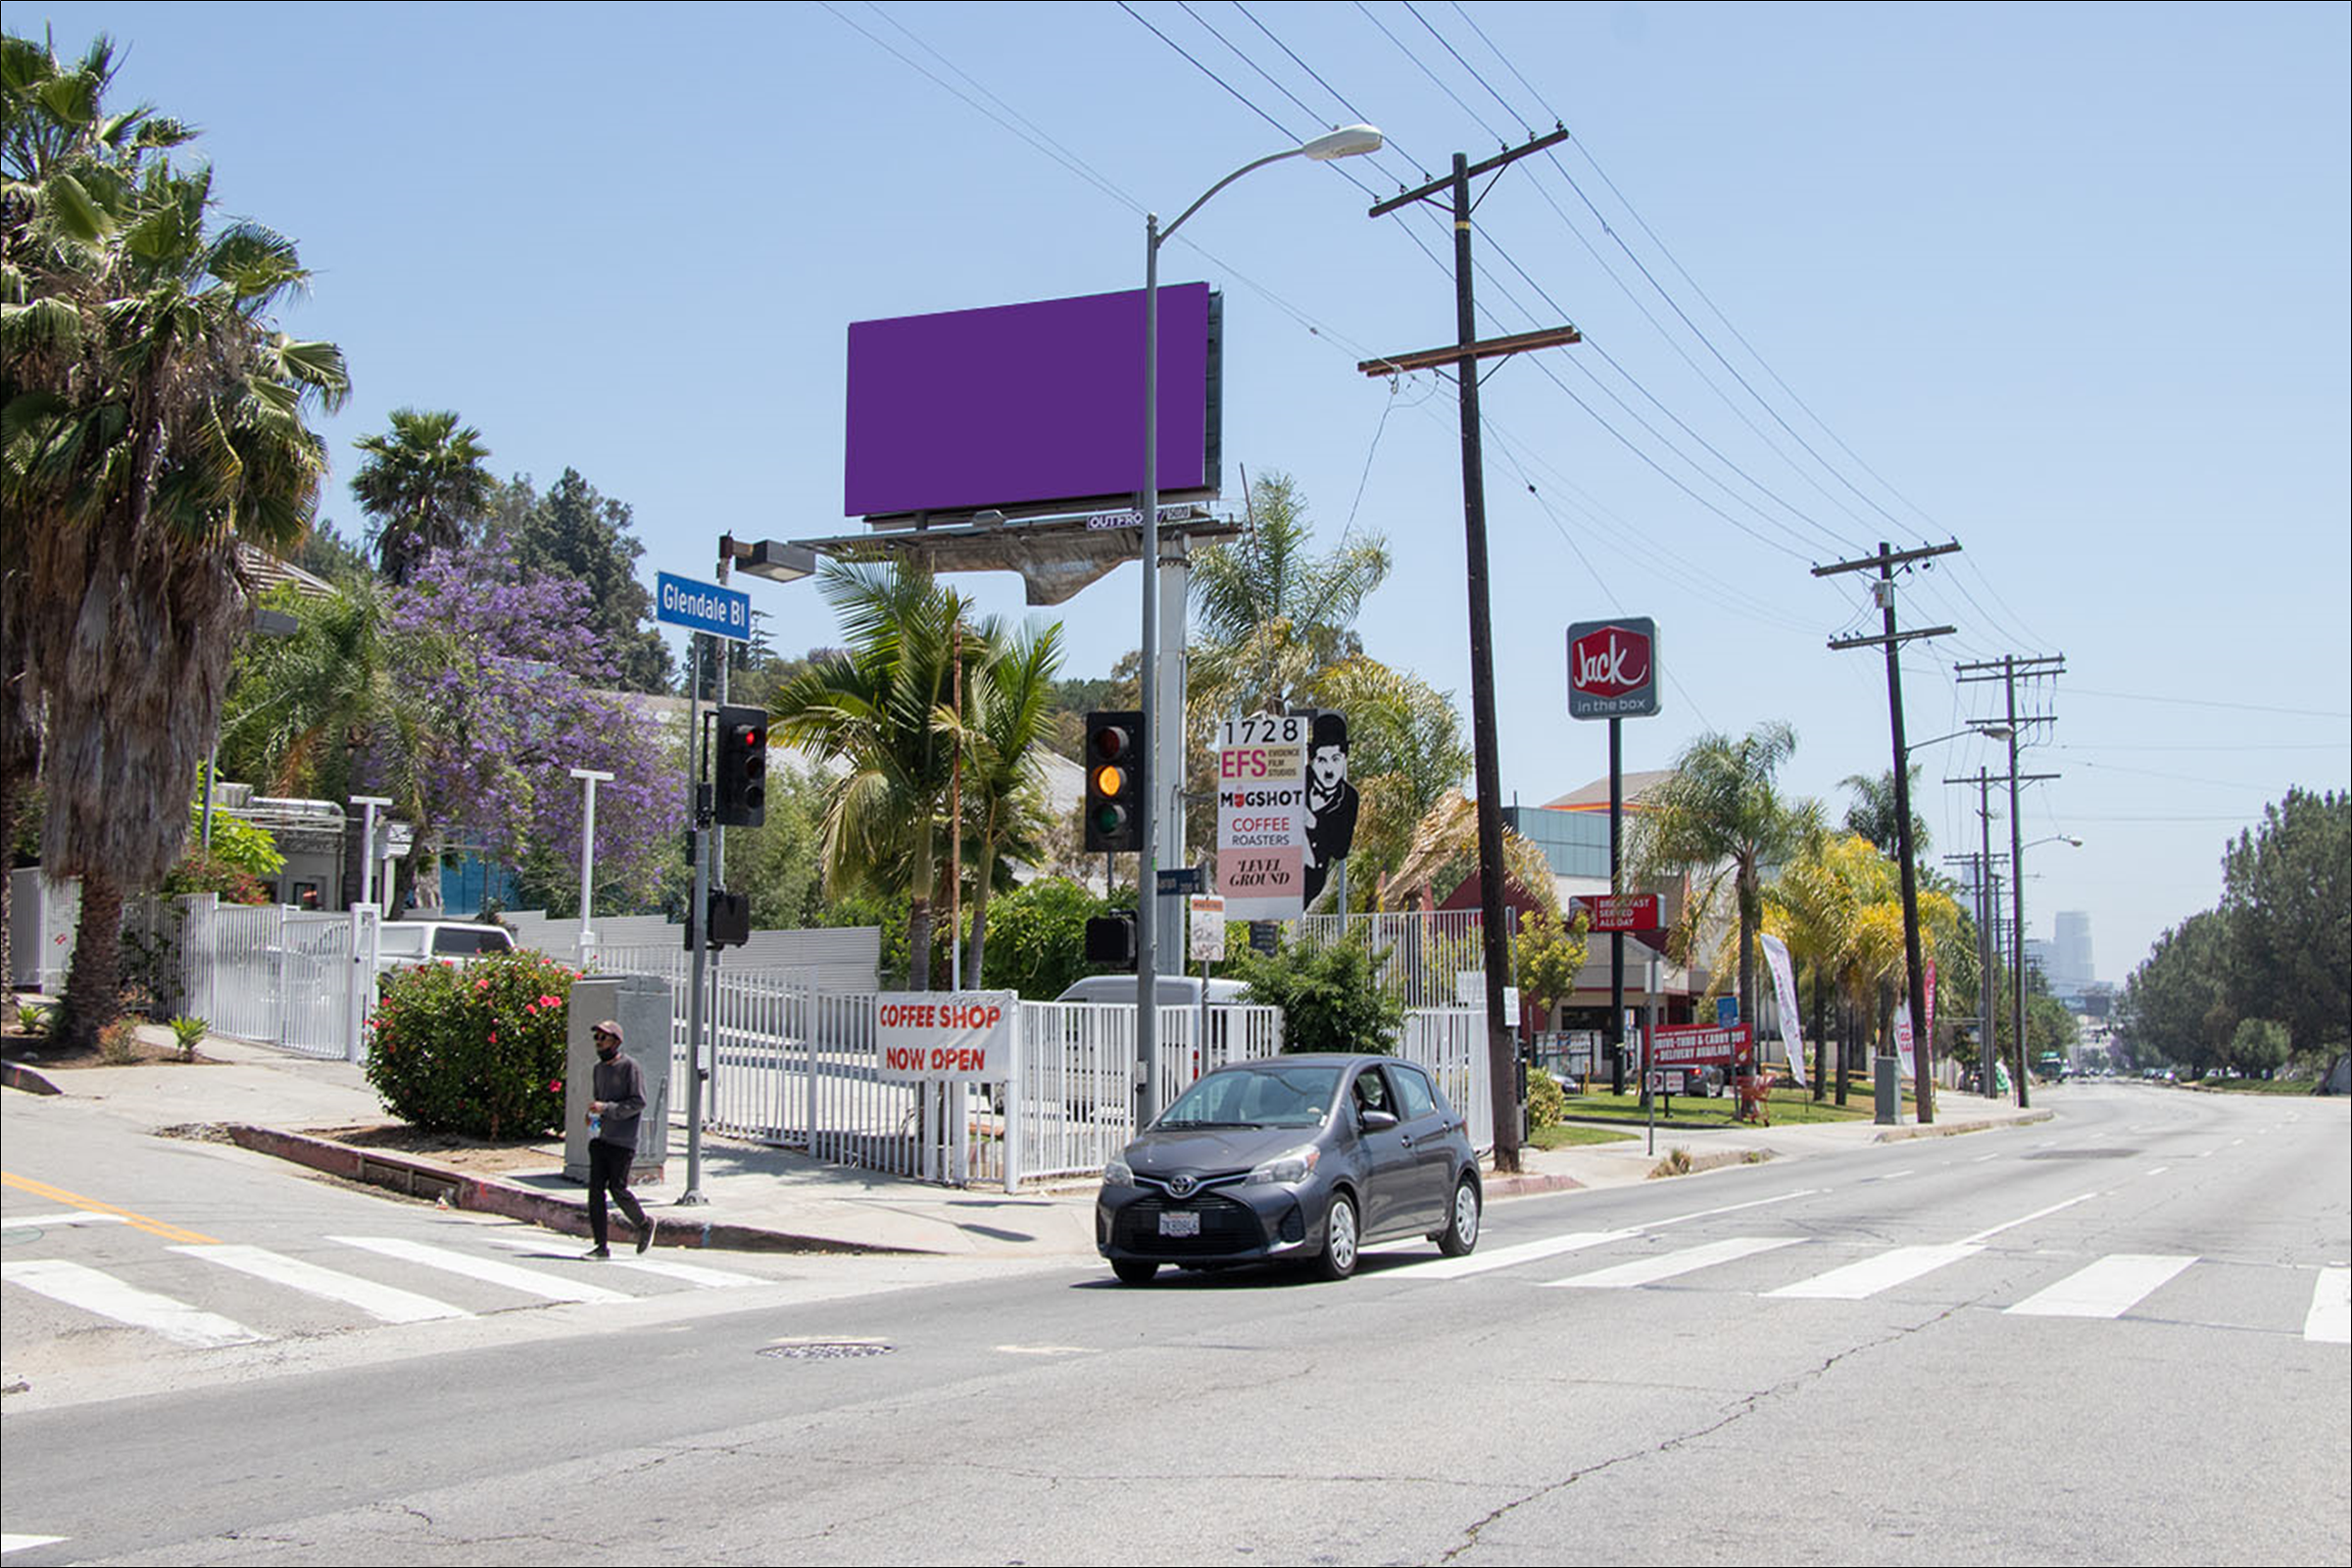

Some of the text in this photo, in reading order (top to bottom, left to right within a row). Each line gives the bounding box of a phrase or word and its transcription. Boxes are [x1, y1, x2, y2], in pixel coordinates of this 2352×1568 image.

[1089, 512, 1160, 528] OUTFRO
[663, 583, 745, 627] Glendale Bl
[1574, 633, 1647, 688] Jack
[1578, 699, 1646, 712] in the box
[1225, 718, 1298, 745] 1728
[1267, 749, 1299, 758] EVIDENCE
[1221, 749, 1267, 778] EFS
[1267, 768, 1297, 777] STUDIOS
[1232, 817, 1290, 832] COFFEE
[1232, 834, 1290, 846] ROASTERS
[1229, 872, 1290, 887] GROUND
[1599, 899, 1650, 907] BREAST
[1617, 917, 1635, 926] DAY
[880, 1004, 1001, 1029] COFFEE SHOP
[886, 1047, 985, 1071] NOW OPEN
[1660, 1045, 1735, 1060] DELIVERY AVAILAB
